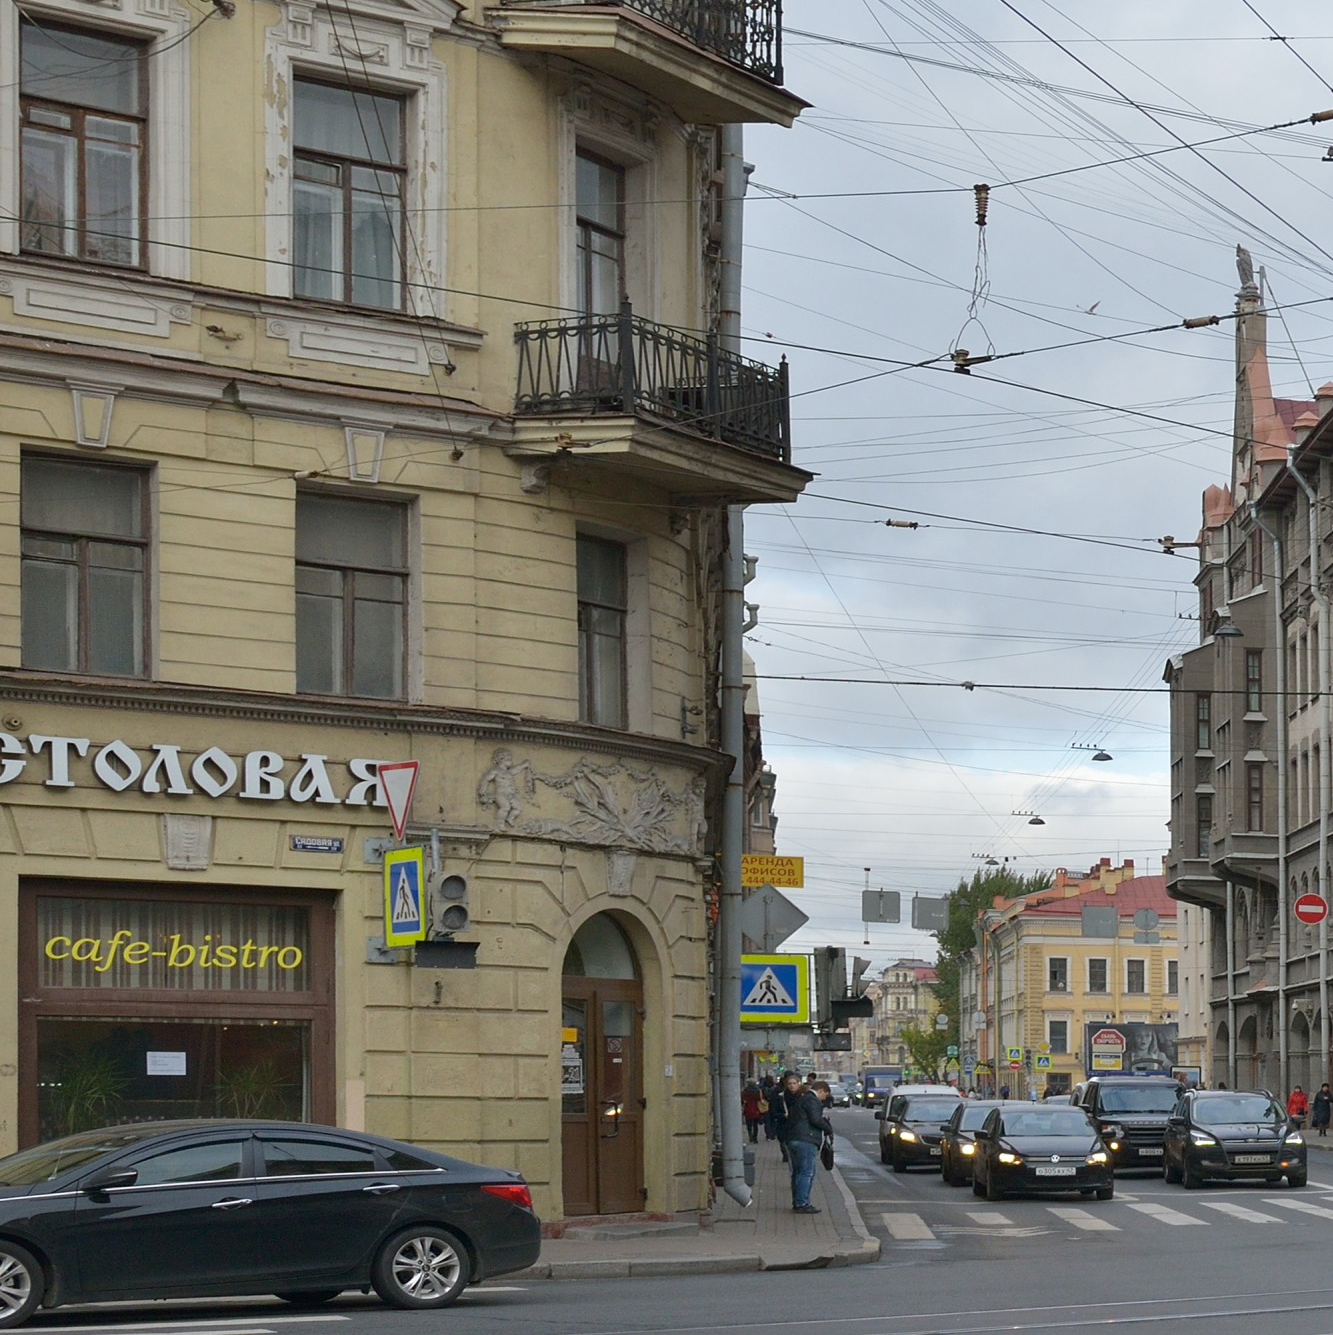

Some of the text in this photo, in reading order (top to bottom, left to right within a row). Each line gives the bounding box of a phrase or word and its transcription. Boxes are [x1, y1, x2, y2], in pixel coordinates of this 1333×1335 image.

[741, 857, 794, 867] АРЕНДА
[741, 866, 795, 876] ОФИСОВ
[45, 930, 303, 972] cafe-bistro
